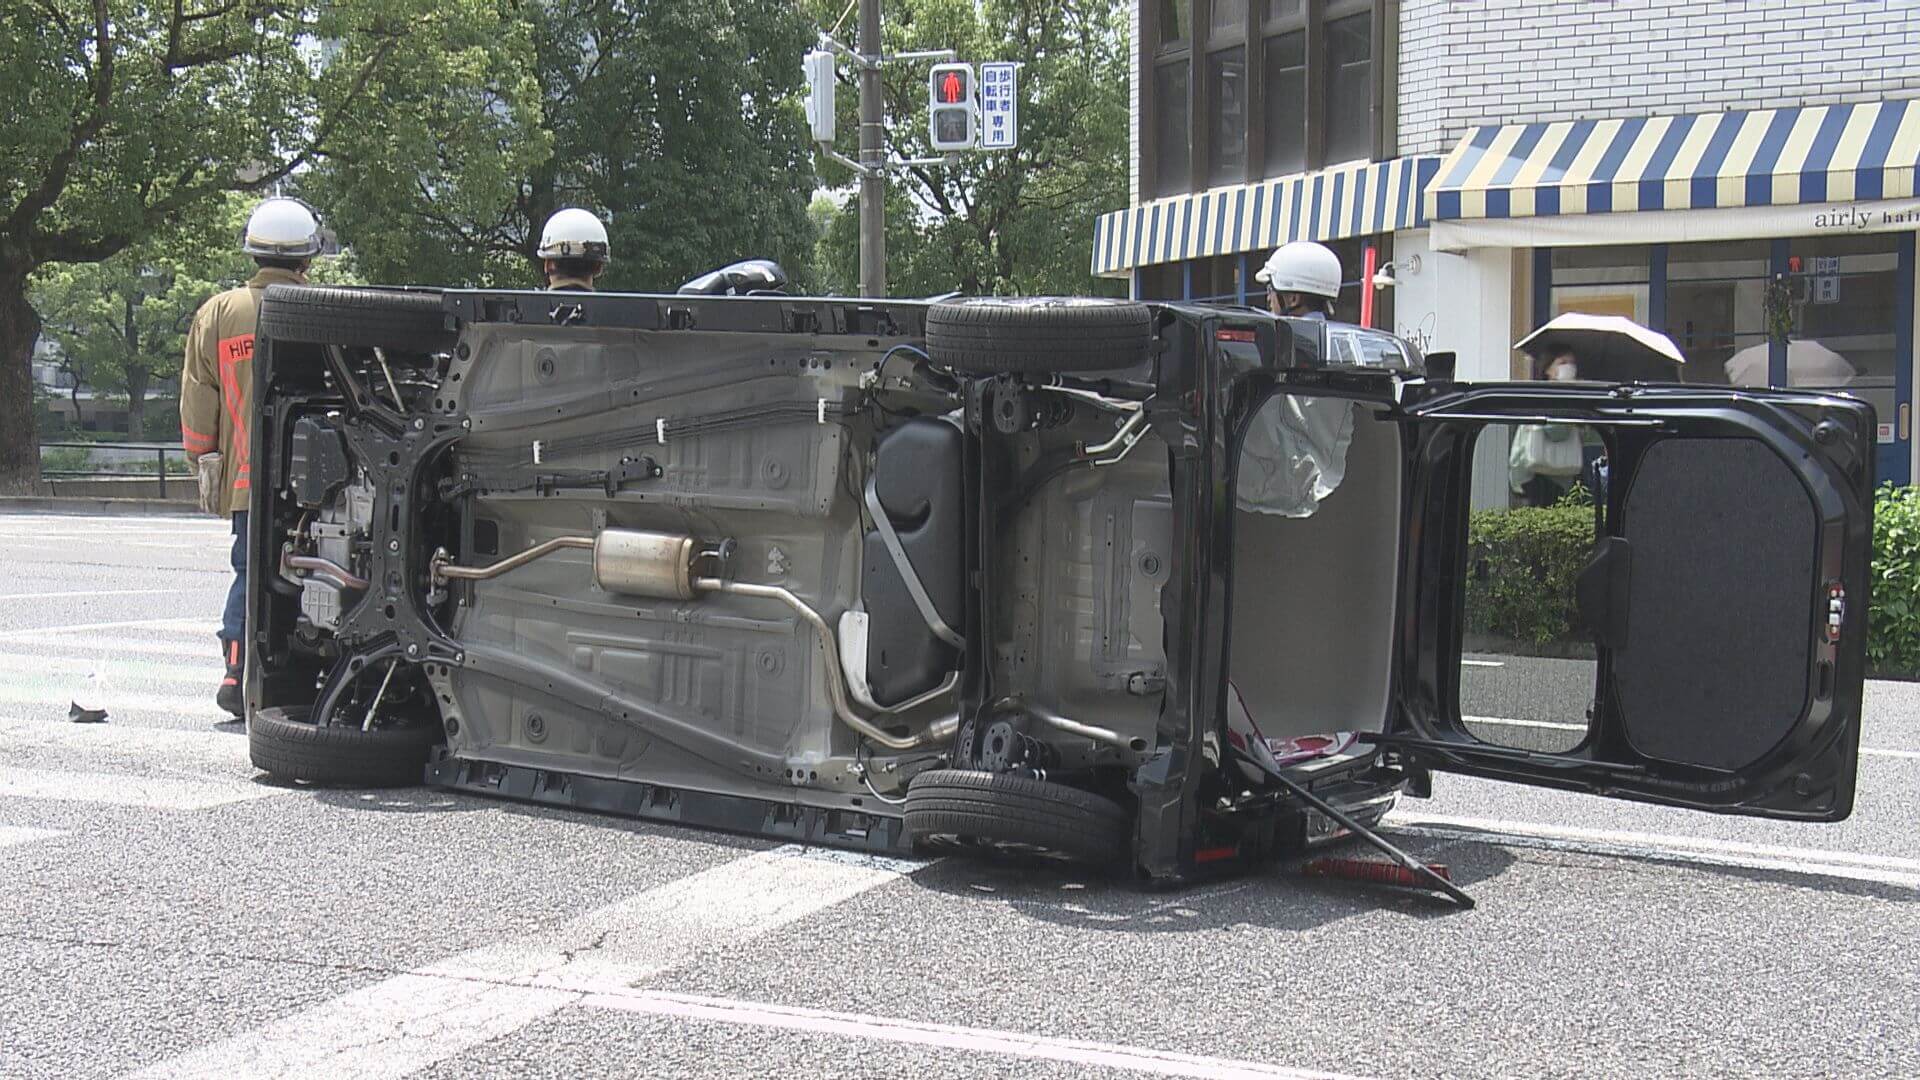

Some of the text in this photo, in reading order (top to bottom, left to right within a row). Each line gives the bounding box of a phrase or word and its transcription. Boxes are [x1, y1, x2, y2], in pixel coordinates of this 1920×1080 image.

[986, 70, 997, 112] 自転車
[1000, 70, 1011, 112] 歩行者
[993, 115, 1005, 142] 専用
[1815, 207, 1872, 229] airly
